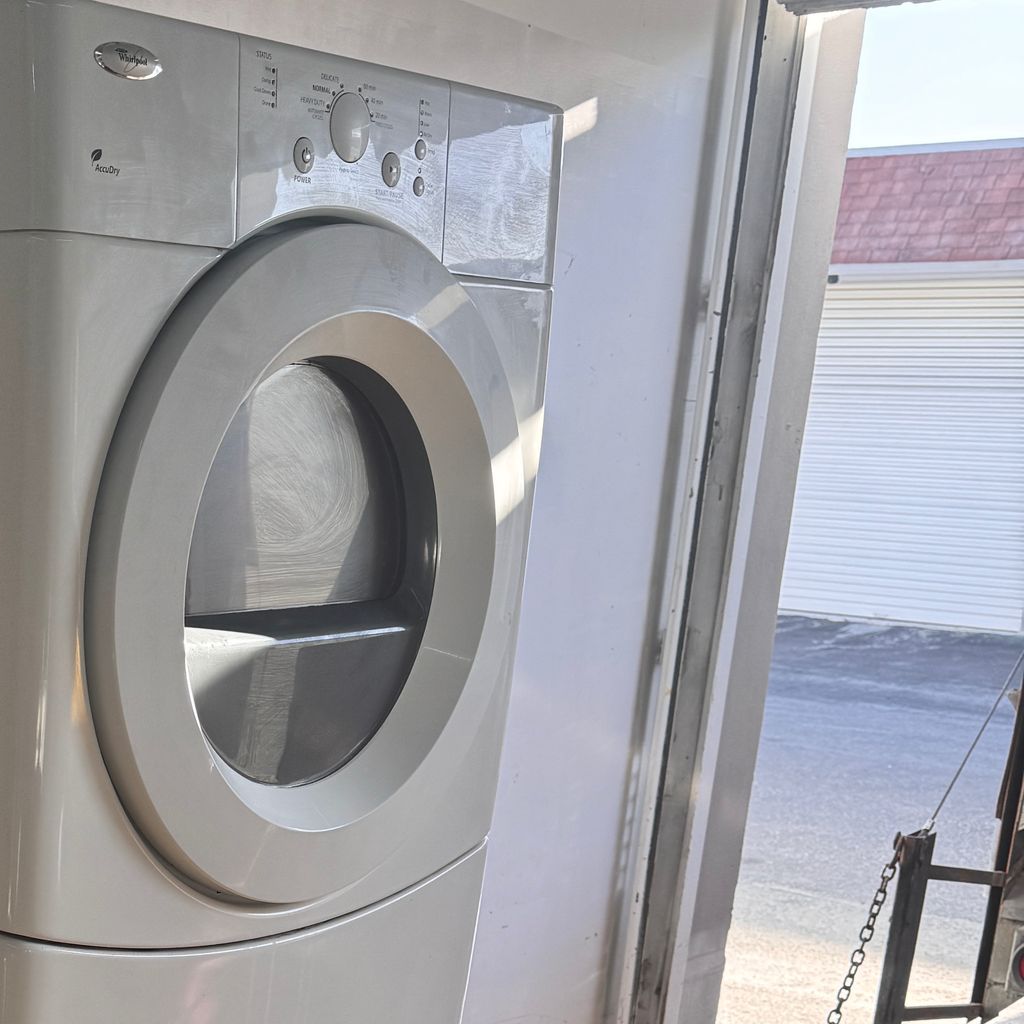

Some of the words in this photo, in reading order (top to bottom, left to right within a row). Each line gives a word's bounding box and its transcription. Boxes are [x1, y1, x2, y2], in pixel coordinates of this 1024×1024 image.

[118, 52, 147, 66] Whirlpool
[256, 50, 272, 60] STATUS
[312, 84, 331, 94] NORMAL
[95, 164, 120, 176] AccuDry
[294, 175, 312, 184] POWER
